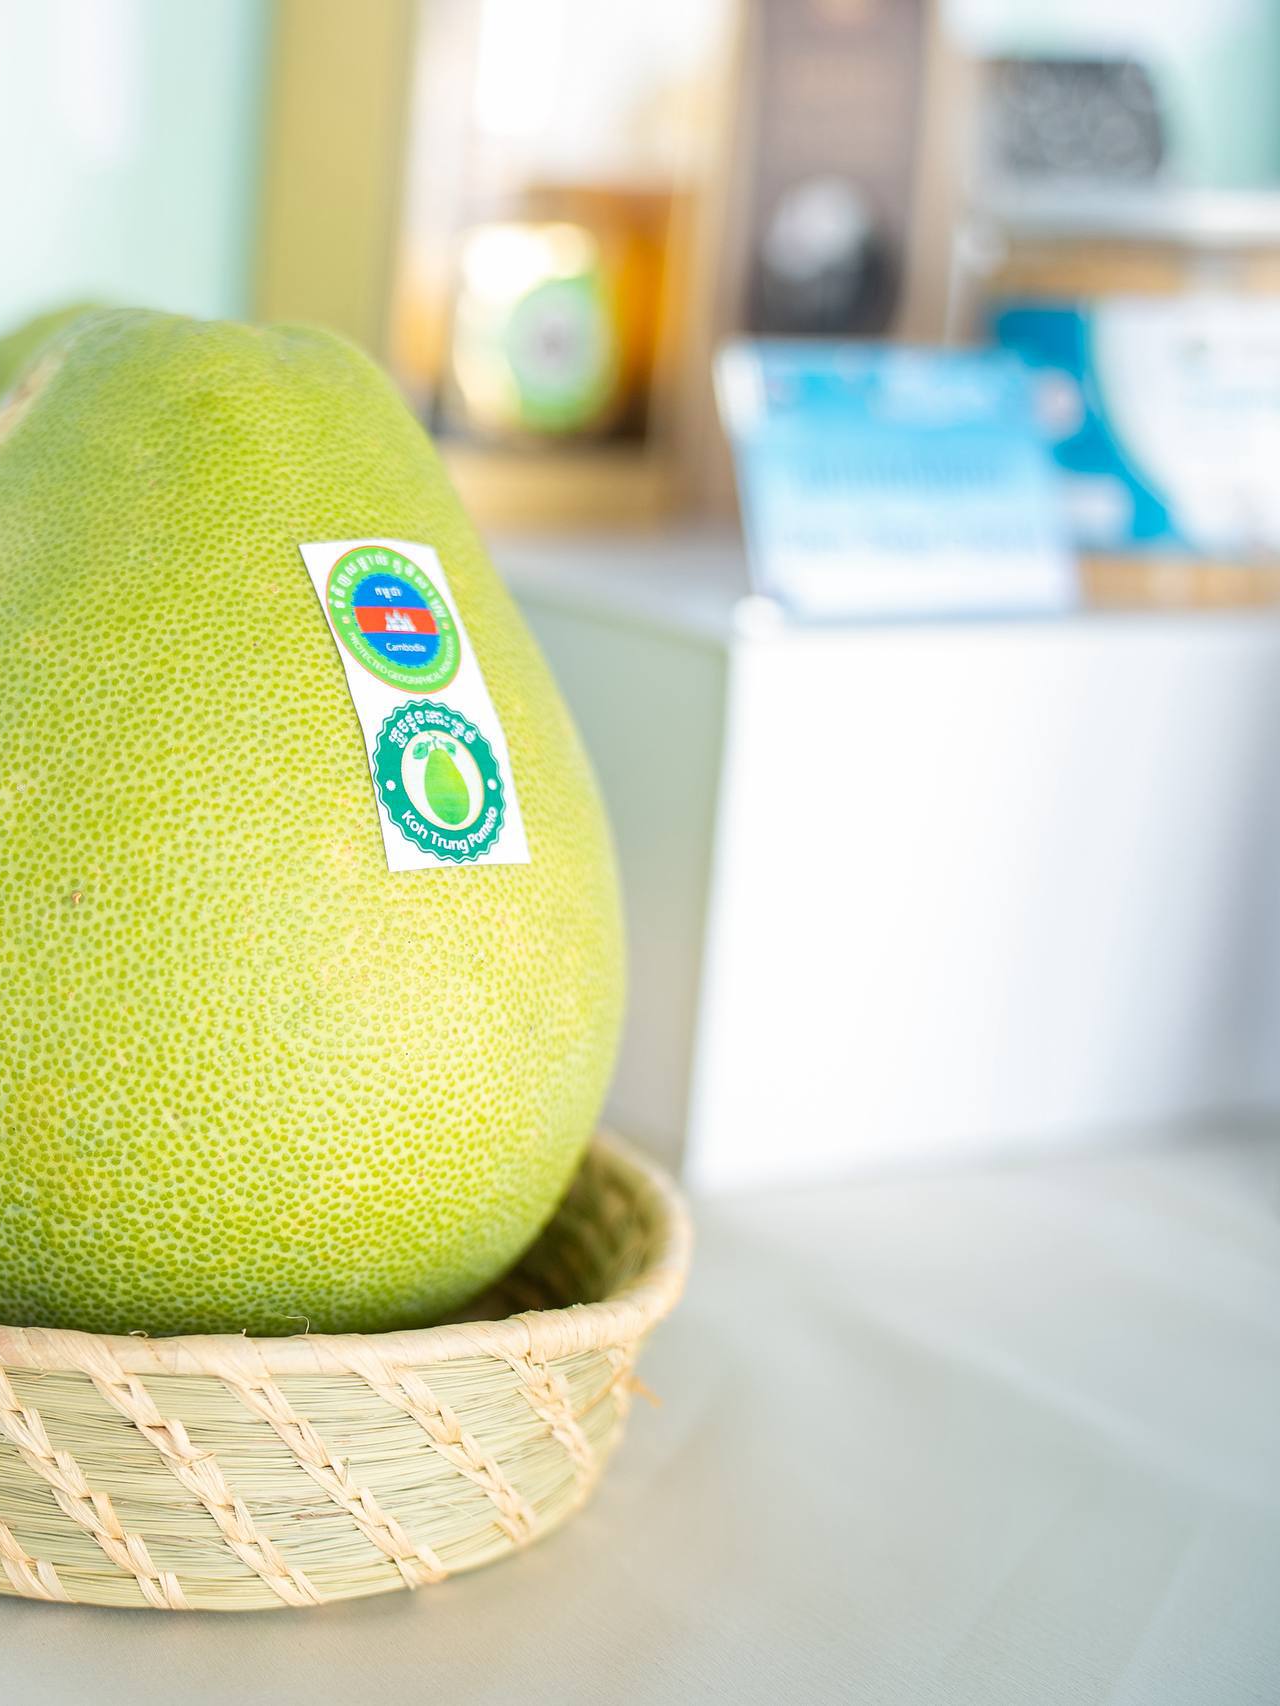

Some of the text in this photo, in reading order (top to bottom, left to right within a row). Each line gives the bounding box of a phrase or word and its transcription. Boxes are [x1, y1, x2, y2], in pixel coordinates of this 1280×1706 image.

[385, 642, 426, 653] Cambodia
[401, 806, 498, 854] Koh Trung Pomelo
